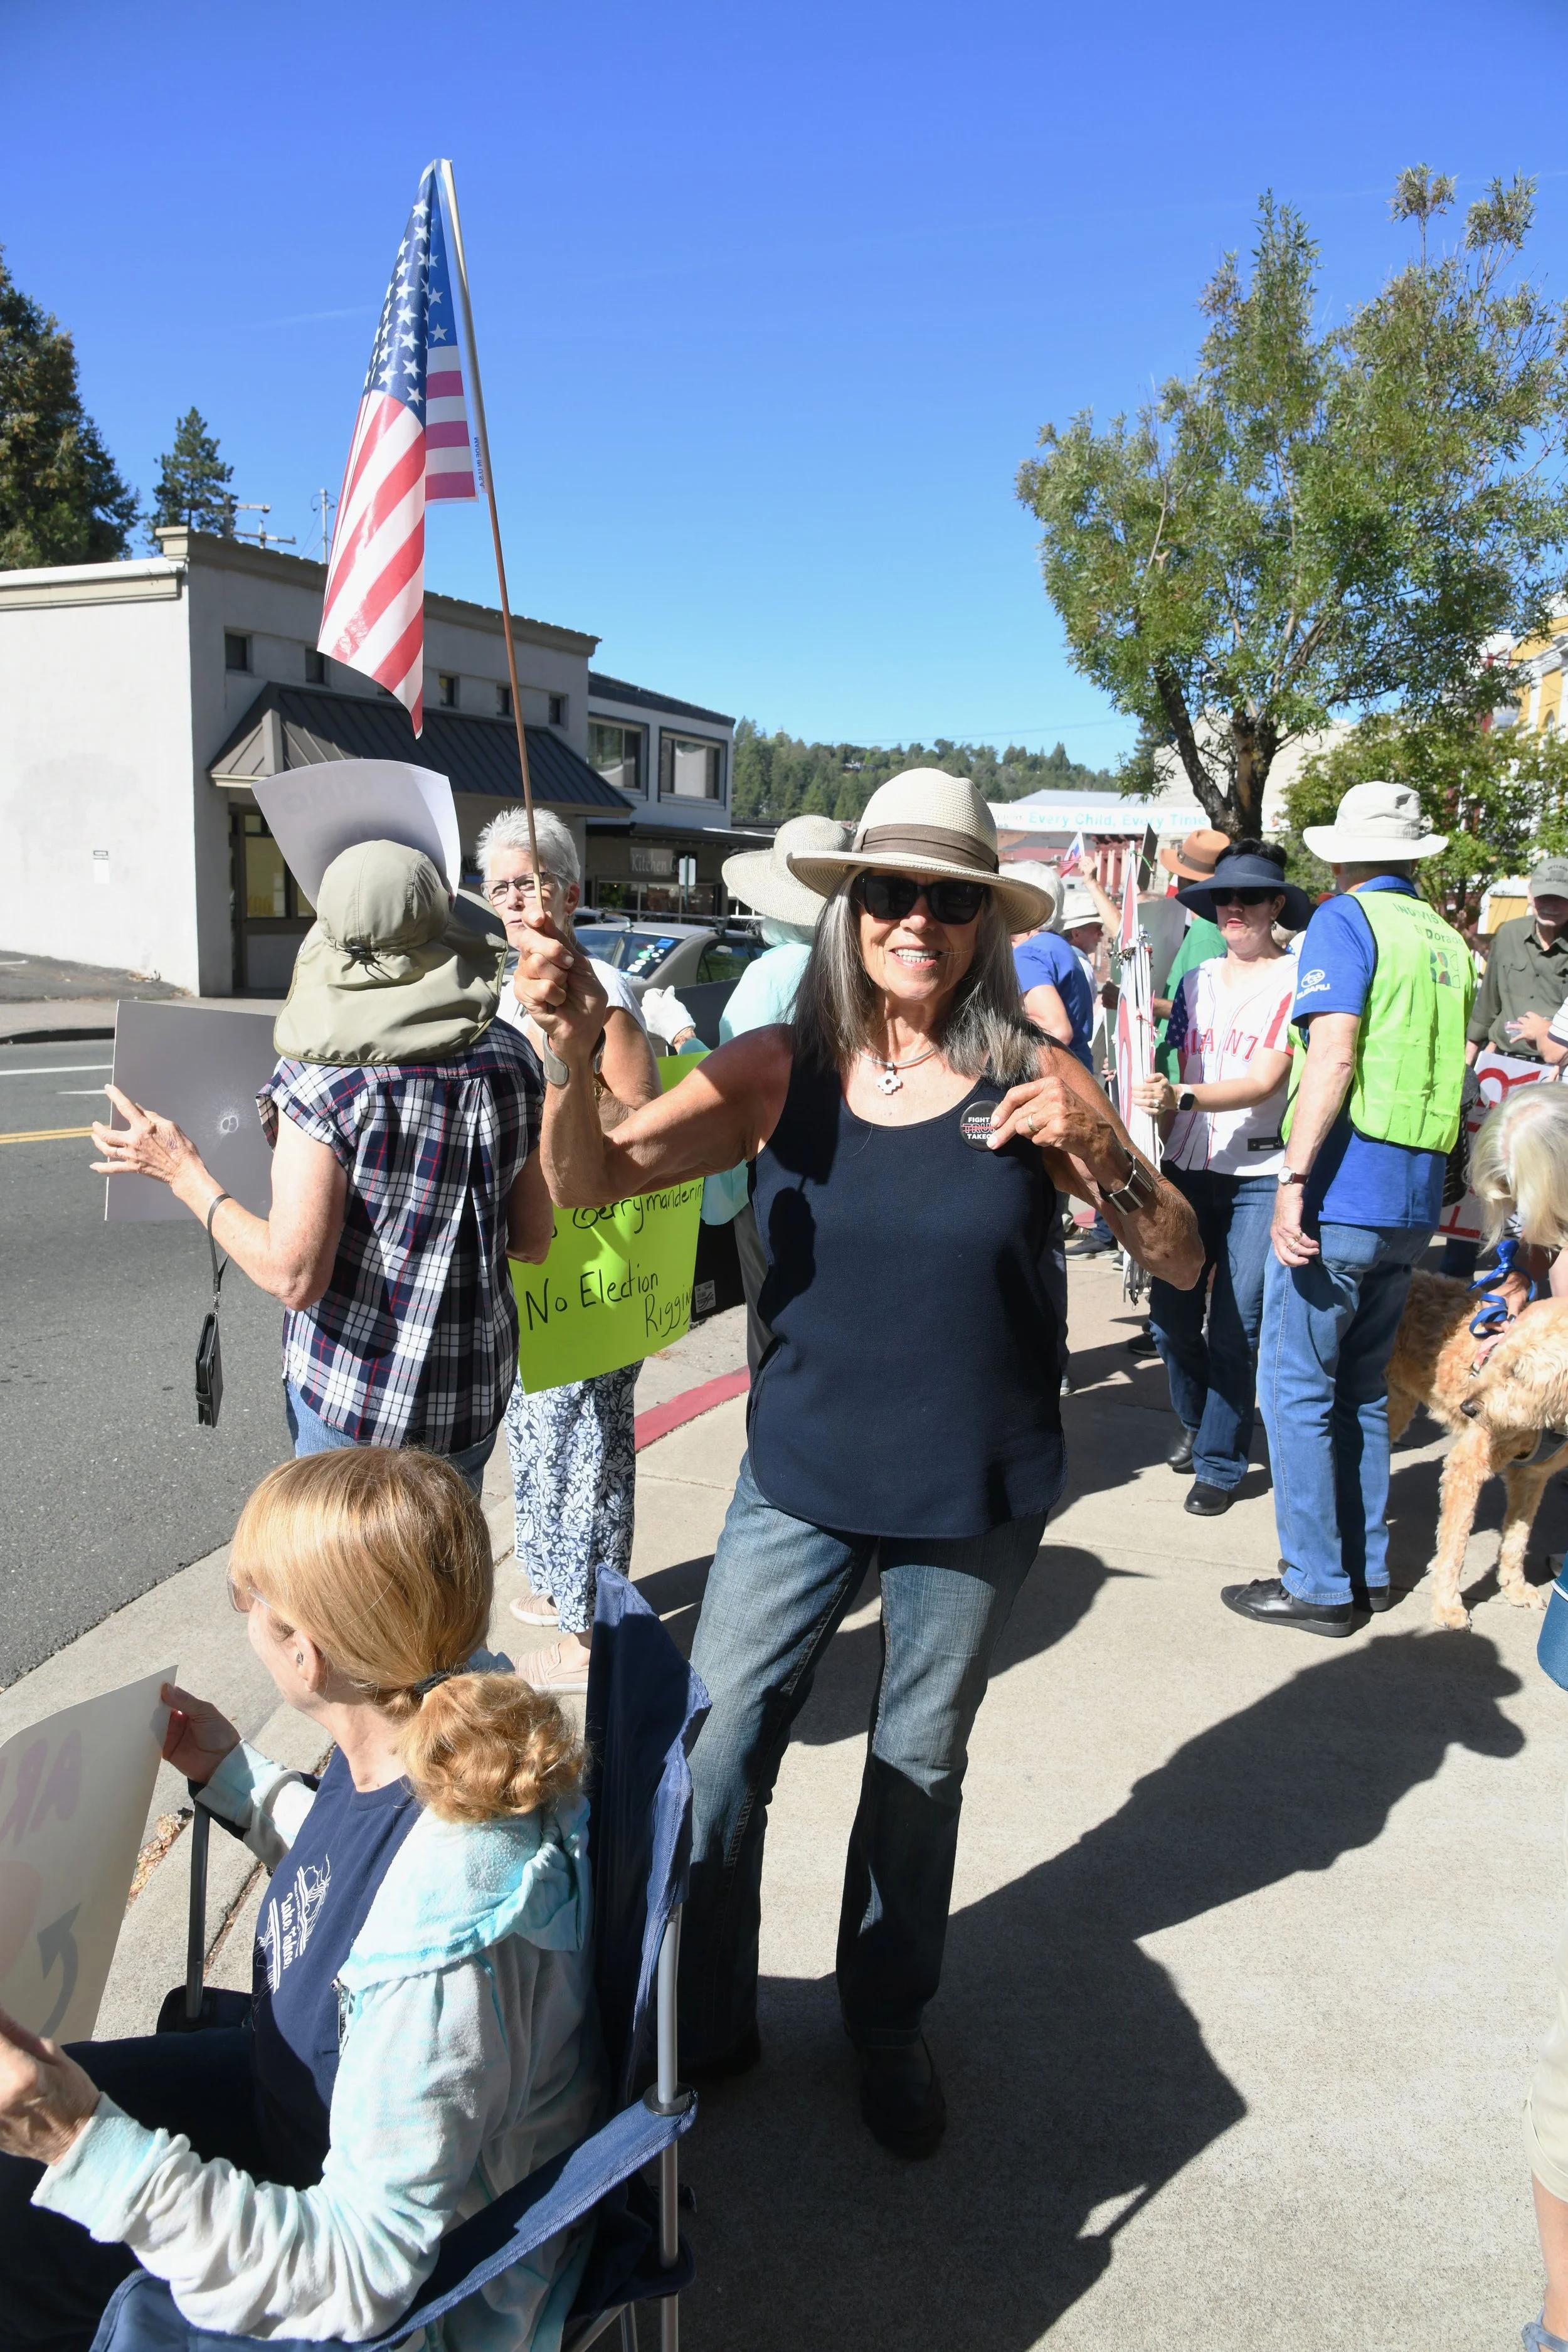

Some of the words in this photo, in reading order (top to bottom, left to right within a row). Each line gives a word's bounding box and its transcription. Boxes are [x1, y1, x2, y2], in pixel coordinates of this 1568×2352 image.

[1029, 812, 1069, 828] Every
[1075, 813, 1116, 827] Child,
[1122, 815, 1164, 829] Every
[1170, 813, 1208, 825] Time
[632, 852, 668, 872] Kitchen
[1296, 983, 1330, 1000] SUBARU
[1184, 1027, 1259, 1062] IANT
[572, 1183, 703, 1234] Gerrymanderin
[525, 1278, 568, 1331] No
[580, 1259, 659, 1308] Election
[281, 1892, 295, 1932] Lake
[282, 1925, 298, 1971] Tahoe
